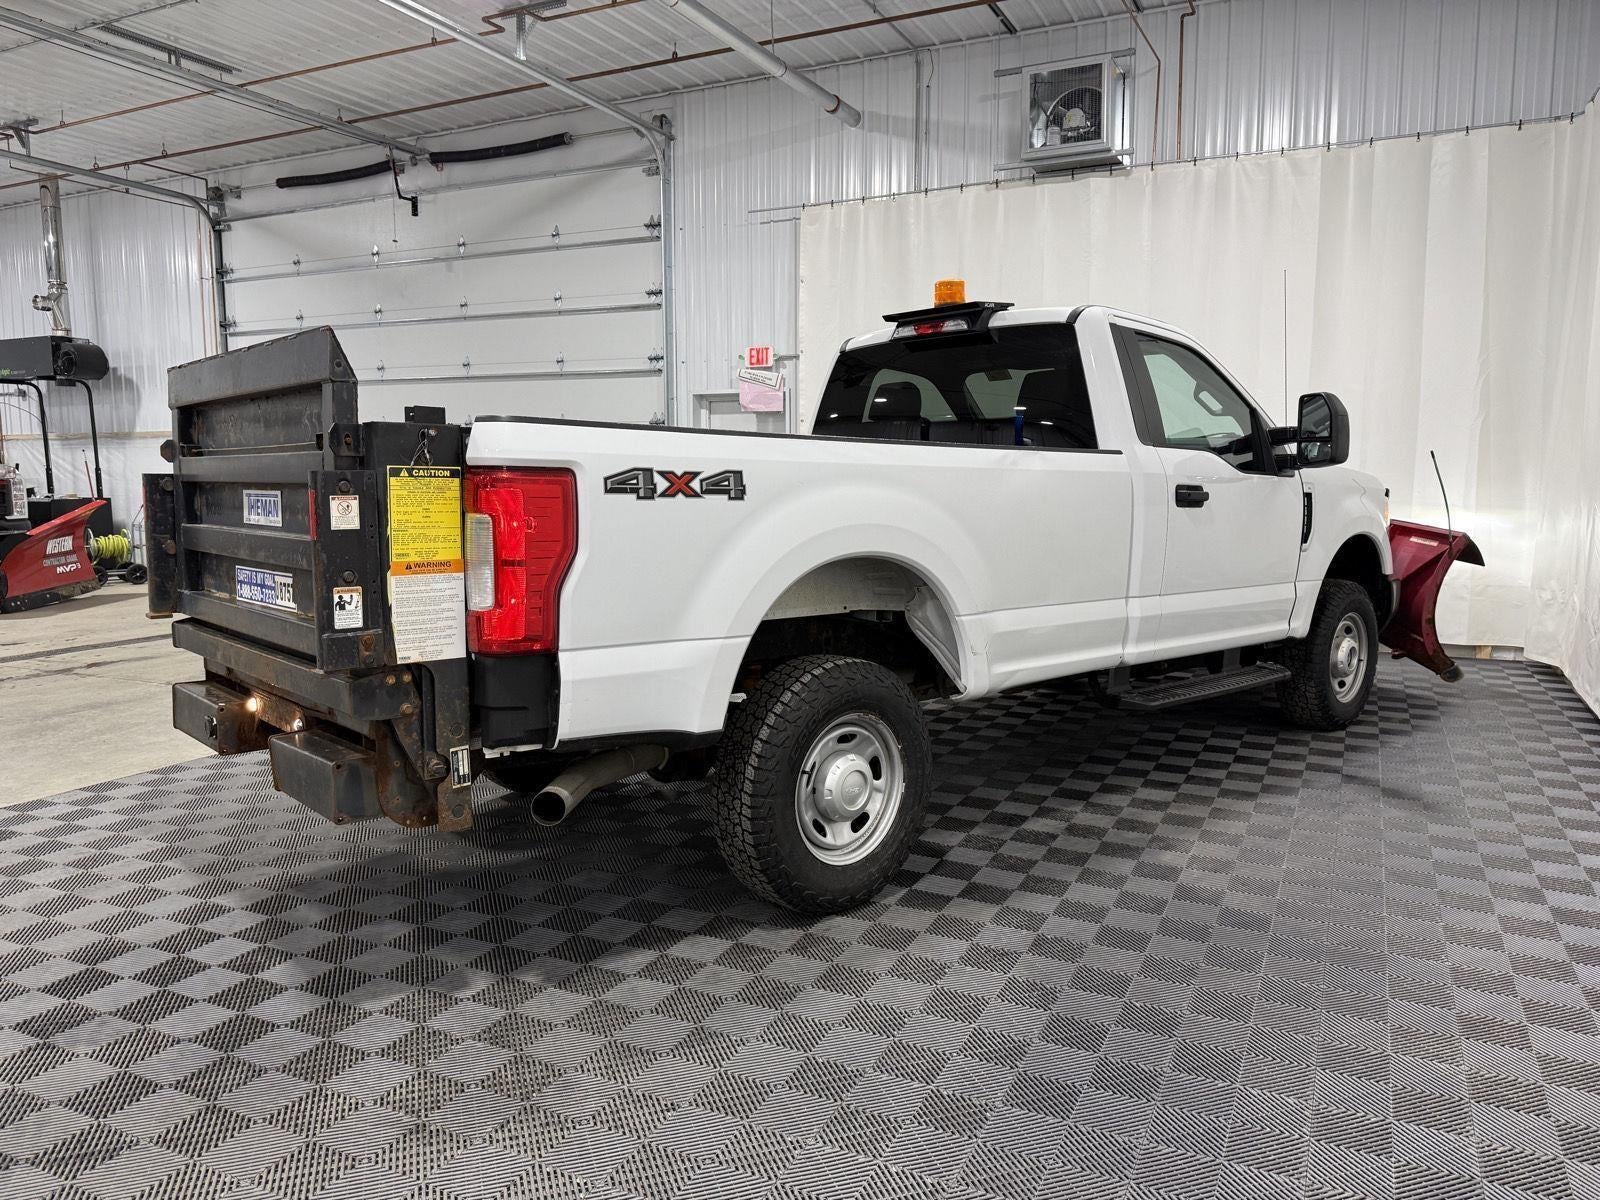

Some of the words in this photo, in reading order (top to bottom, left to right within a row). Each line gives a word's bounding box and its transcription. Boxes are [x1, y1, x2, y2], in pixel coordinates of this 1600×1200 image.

[749, 347, 769, 366] EXIT
[412, 469, 450, 477] CAUTION
[603, 467, 747, 501] 4X4
[46, 535, 73, 555] WESTERN
[413, 560, 452, 569] WARNING
[237, 569, 251, 583] SAFETY
